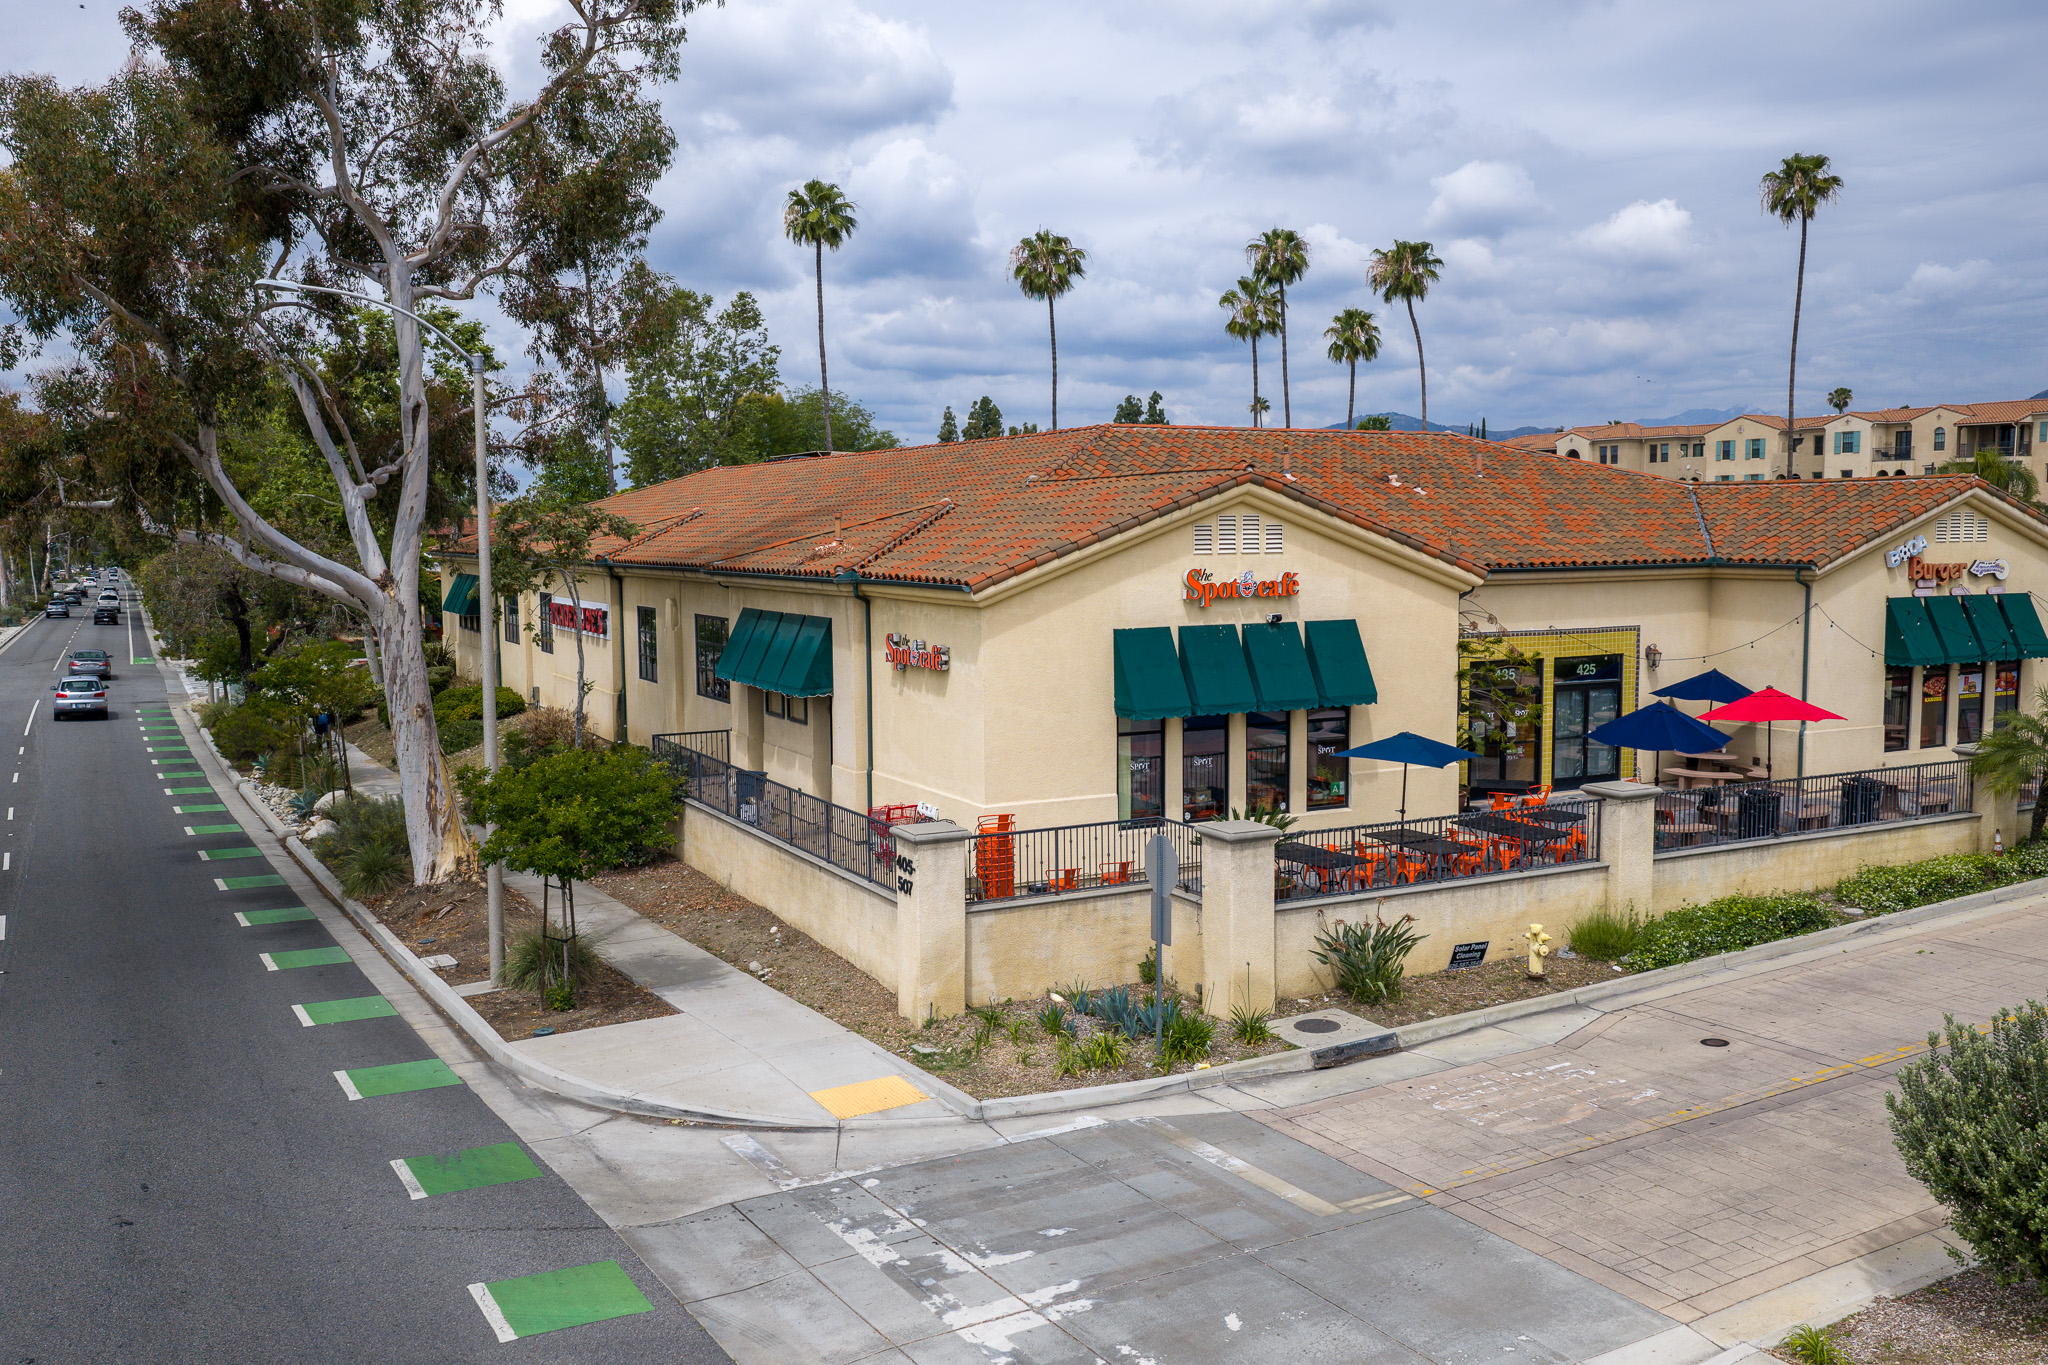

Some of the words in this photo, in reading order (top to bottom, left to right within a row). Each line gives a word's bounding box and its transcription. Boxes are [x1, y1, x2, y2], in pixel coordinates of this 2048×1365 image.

[1909, 557, 1967, 585] Burger
[1184, 568, 1241, 607] Spot
[1257, 571, 1299, 597] café
[550, 602, 579, 628] TRADER
[581, 607, 603, 634] JOE'S
[885, 633, 911, 670] Spot
[920, 645, 943, 670] café
[1576, 663, 1596, 676] 425
[1332, 785, 1339, 793] A
[897, 875, 913, 896] 507
[1456, 951, 1482, 959] Cleaning
[1470, 942, 1488, 950] Panel
